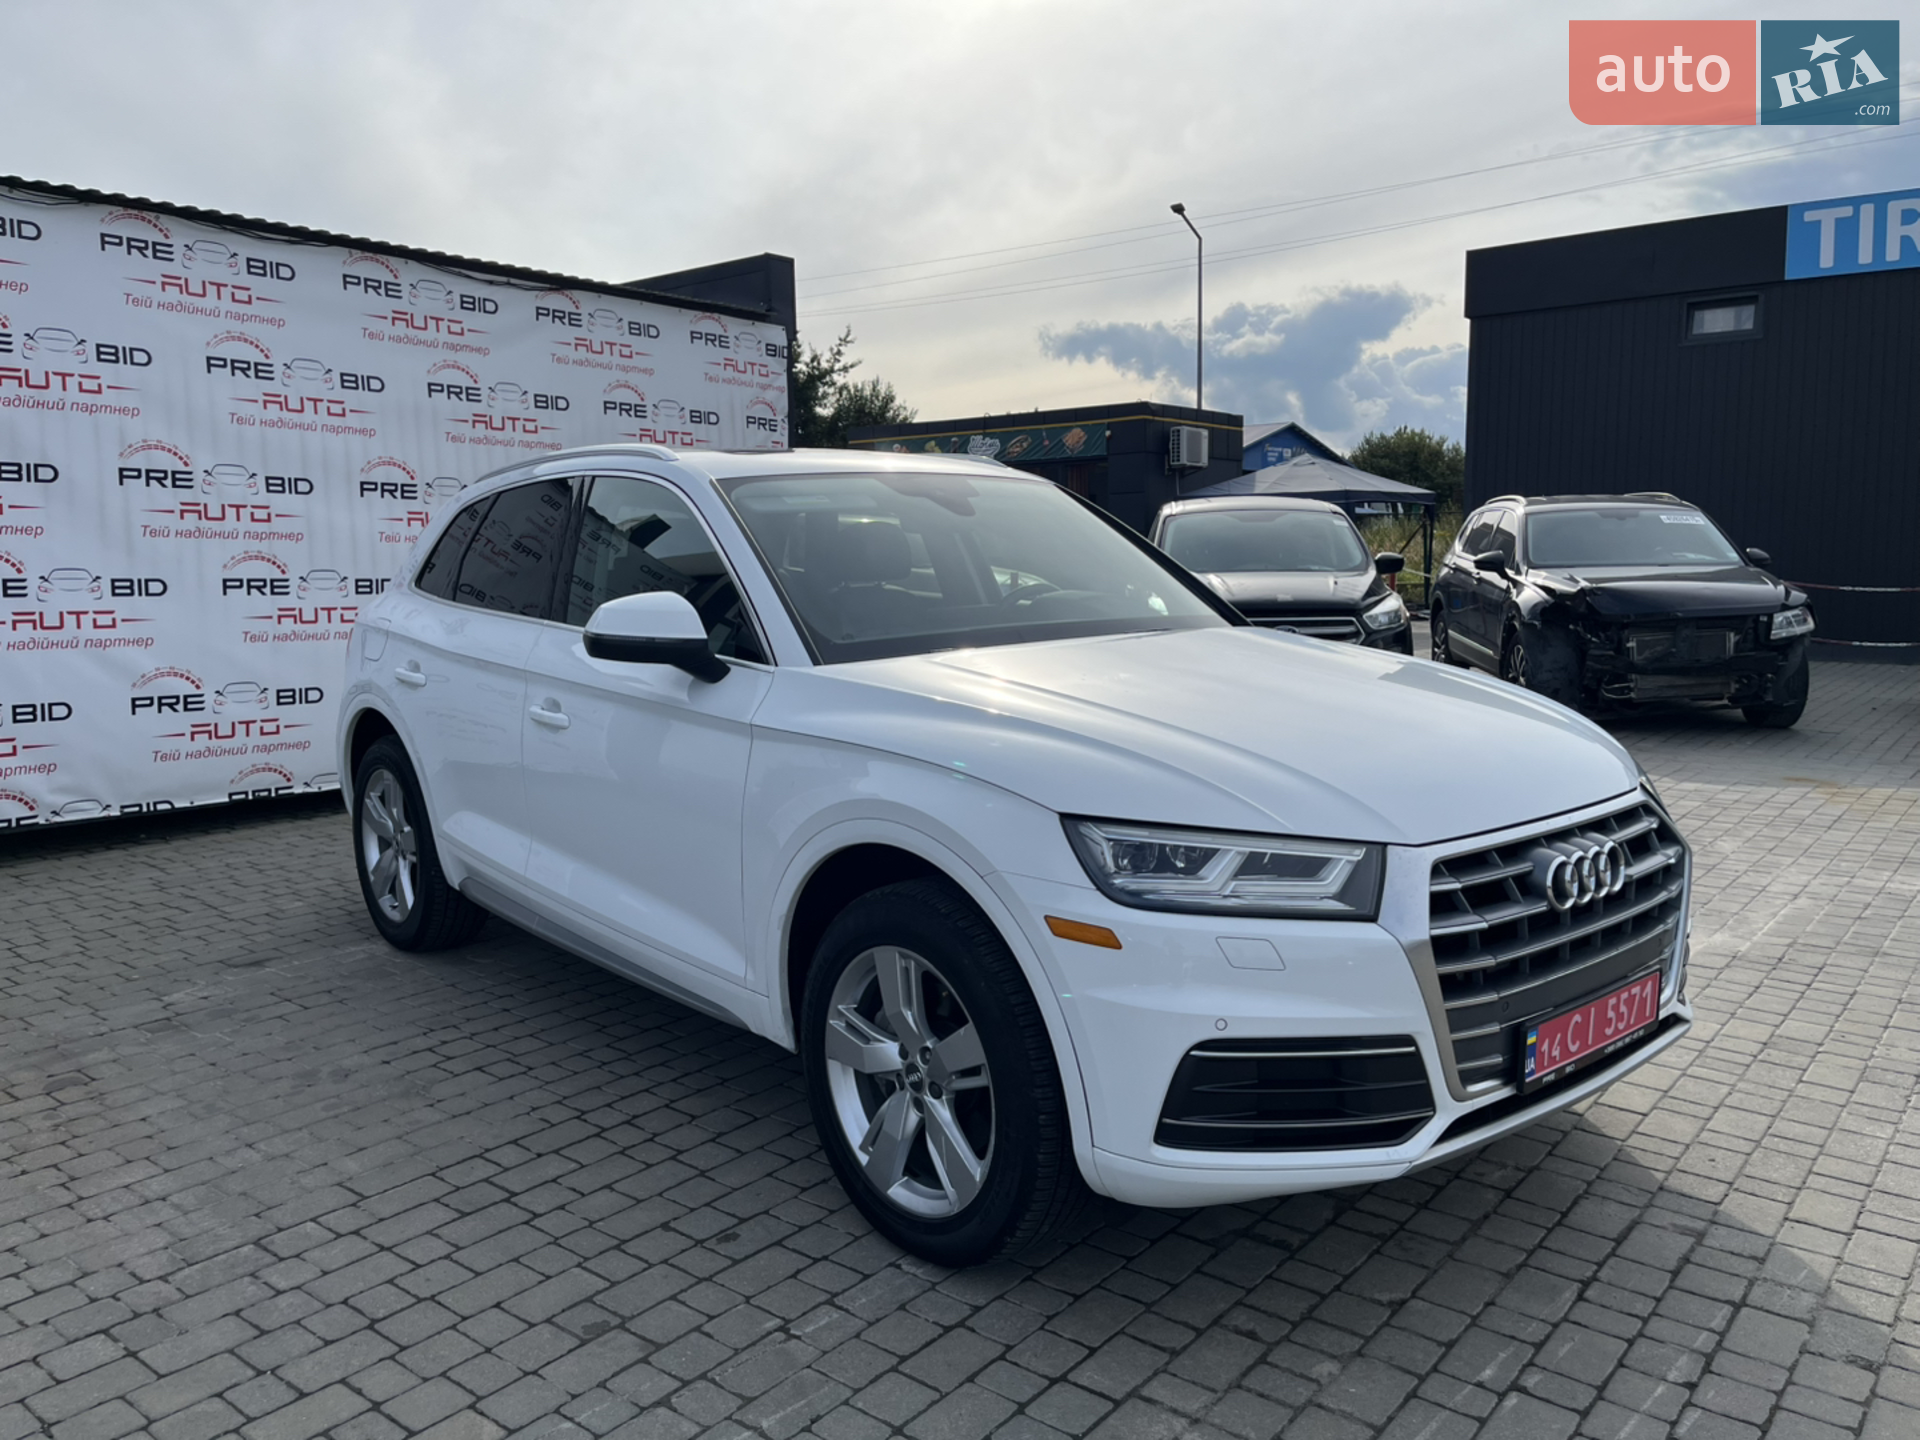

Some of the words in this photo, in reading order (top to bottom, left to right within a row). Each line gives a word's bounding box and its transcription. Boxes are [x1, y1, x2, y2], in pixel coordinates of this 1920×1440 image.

[0, 216, 42, 241] ID
[1803, 198, 1920, 269] TIR
[100, 232, 175, 262] PRE
[246, 257, 296, 281] BID
[160, 274, 253, 305] AUTO
[342, 273, 403, 299] PRE
[460, 294, 499, 315] BID
[123, 293, 152, 308] Твій
[157, 299, 221, 318] надійний
[225, 308, 286, 329] партнер
[391, 309, 465, 336] AUTO
[535, 306, 583, 328] PRE
[628, 321, 660, 339] BID
[574, 336, 633, 359] AUTO
[690, 330, 730, 349] PRE
[95, 343, 152, 367] BID
[206, 355, 275, 381] PRE
[339, 371, 385, 393] BID
[723, 357, 769, 378] AUTO
[0, 394, 66, 411] адійний
[70, 400, 140, 419] партнер
[262, 392, 346, 418] AUTO
[427, 382, 482, 403] PRE
[533, 393, 570, 411] BID
[472, 413, 538, 434] AUTO
[603, 400, 648, 419] PRE
[689, 409, 720, 426] BID
[746, 415, 778, 432] PRE
[228, 412, 256, 426] Твій
[259, 416, 317, 432] надійний
[321, 423, 376, 438] партнер
[639, 428, 694, 446] AUTO
[0, 462, 59, 483] BID
[118, 467, 194, 489] PRE
[264, 475, 314, 495] BID
[359, 481, 418, 500] PRE
[179, 501, 272, 523] AUTO
[140, 525, 170, 539] Твій
[175, 526, 239, 541] надійний
[243, 529, 304, 544] партнер
[110, 578, 168, 597] BID
[222, 578, 290, 596] PRE
[11, 610, 117, 631] AUTO
[277, 607, 358, 625] AUTO
[7, 637, 79, 651] надійний
[84, 637, 154, 650] партнер
[242, 631, 268, 643] Твій
[272, 628, 330, 642] надійний
[130, 693, 206, 715] PRE
[276, 687, 324, 706] BID
[12, 702, 73, 724] BID
[190, 718, 280, 742] AUTO
[151, 750, 181, 763] Твій
[185, 744, 249, 760] надійний
[251, 740, 311, 755] партнер
[1541, 1033, 1561, 1067] 14
[1604, 980, 1653, 1037] 5571
[1525, 1057, 1536, 1073] UA
